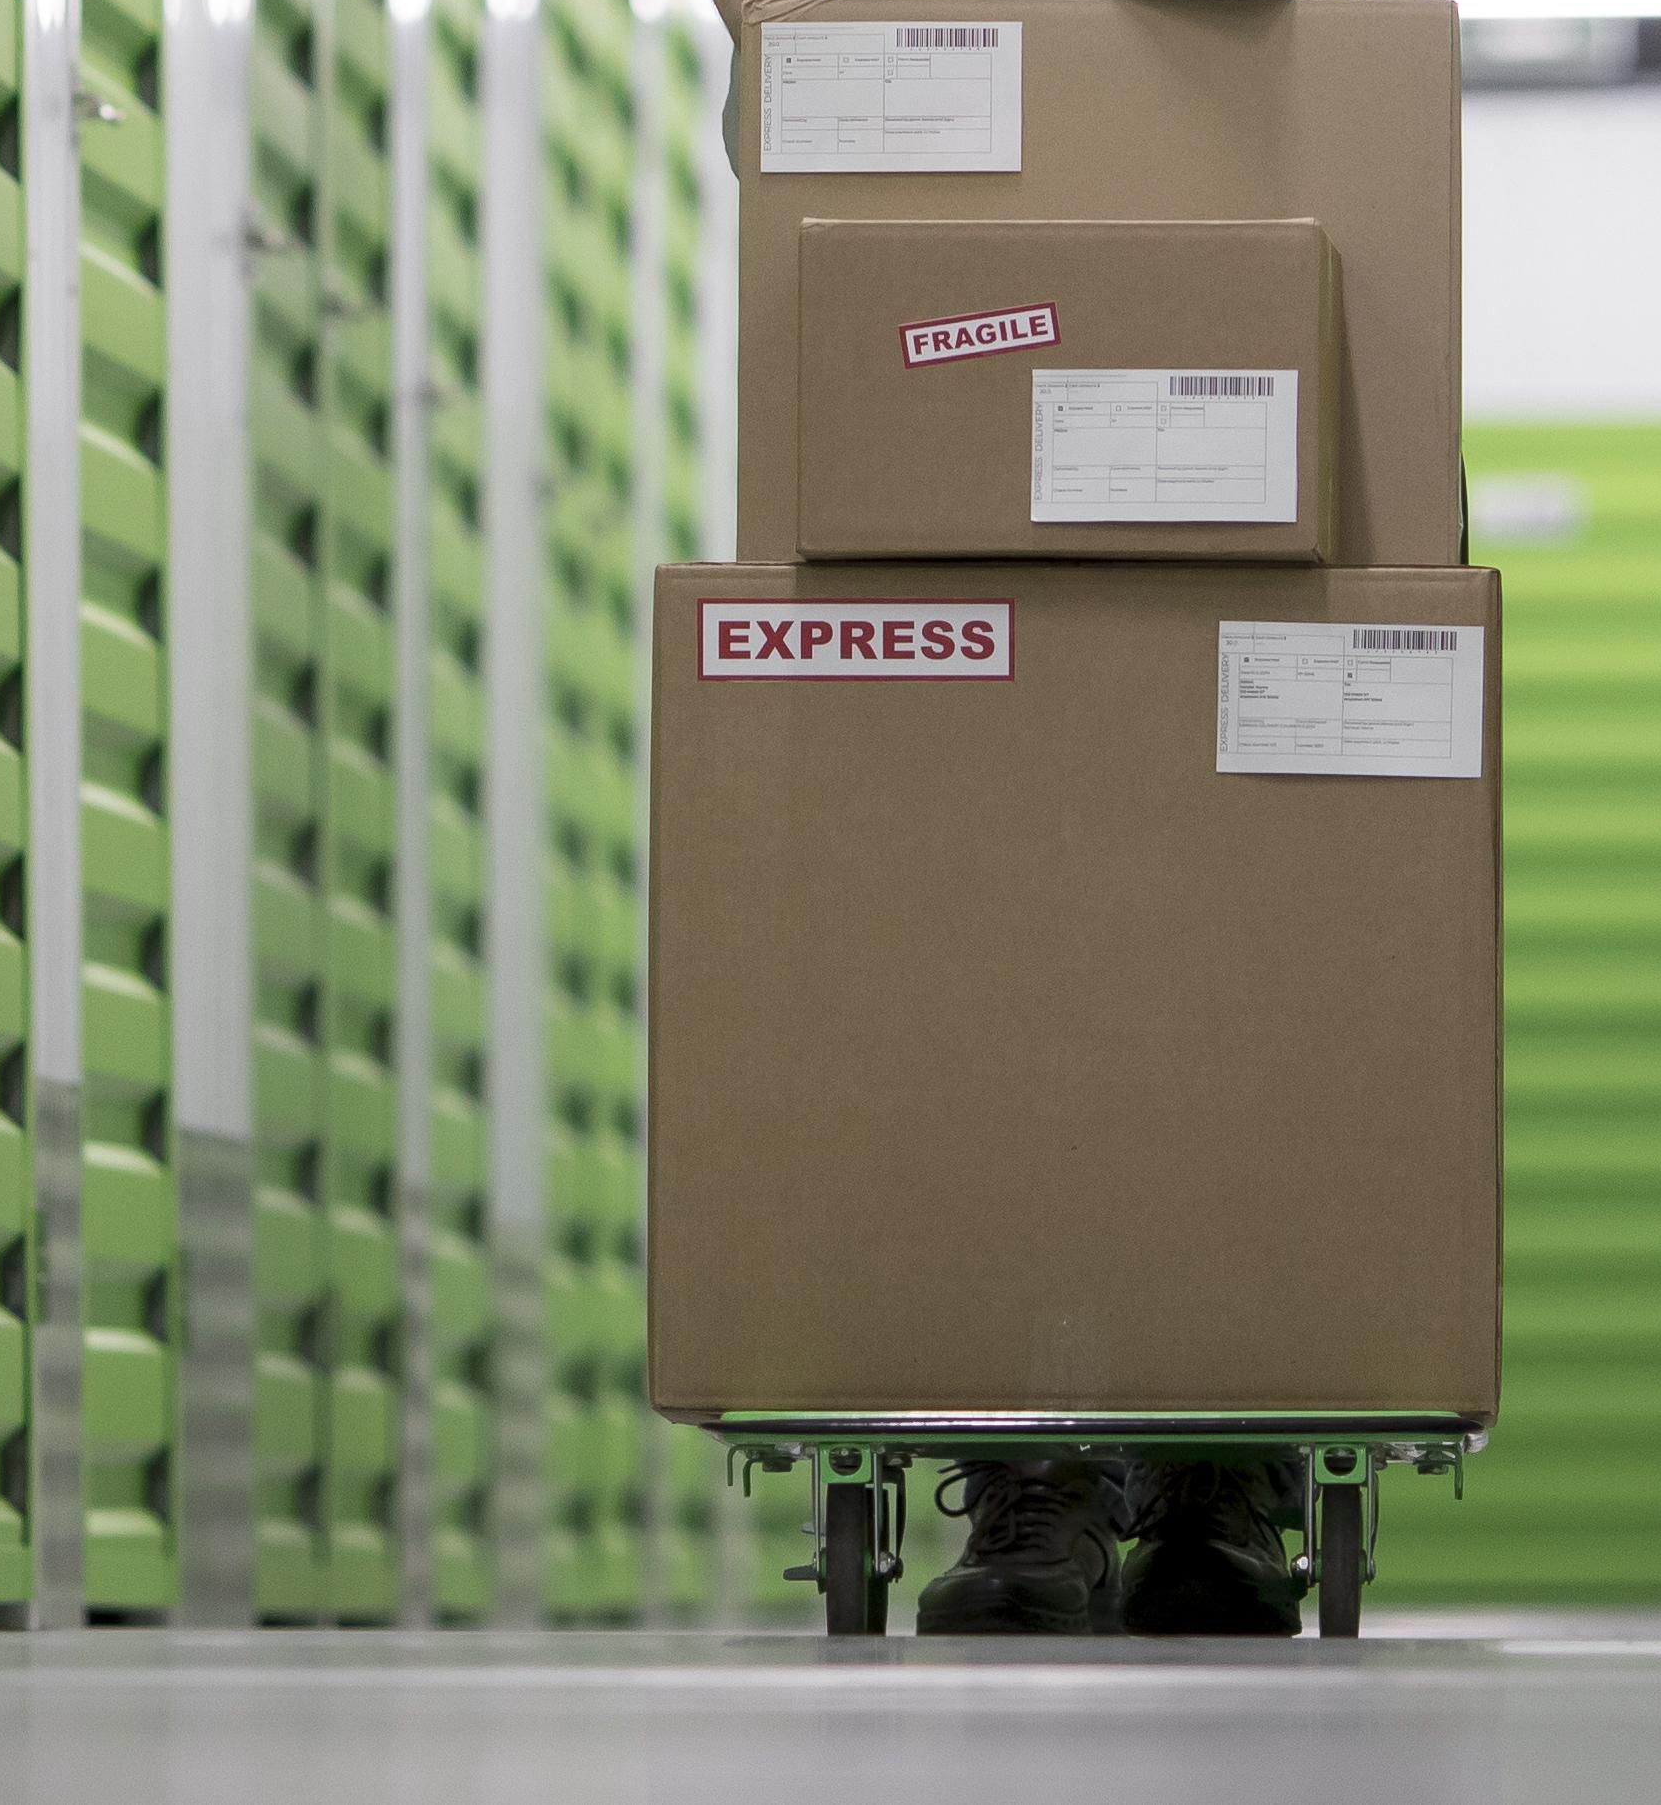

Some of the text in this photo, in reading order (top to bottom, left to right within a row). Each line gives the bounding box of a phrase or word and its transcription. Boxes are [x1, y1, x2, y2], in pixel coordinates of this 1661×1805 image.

[763, 53, 773, 152] EXPRESS DELIVERY
[912, 314, 1049, 356] FRAGILE
[1035, 401, 1044, 452] DELIVERY
[717, 619, 997, 661] EXPRESS
[1219, 652, 1230, 752] EXPRESS DELIVERY
